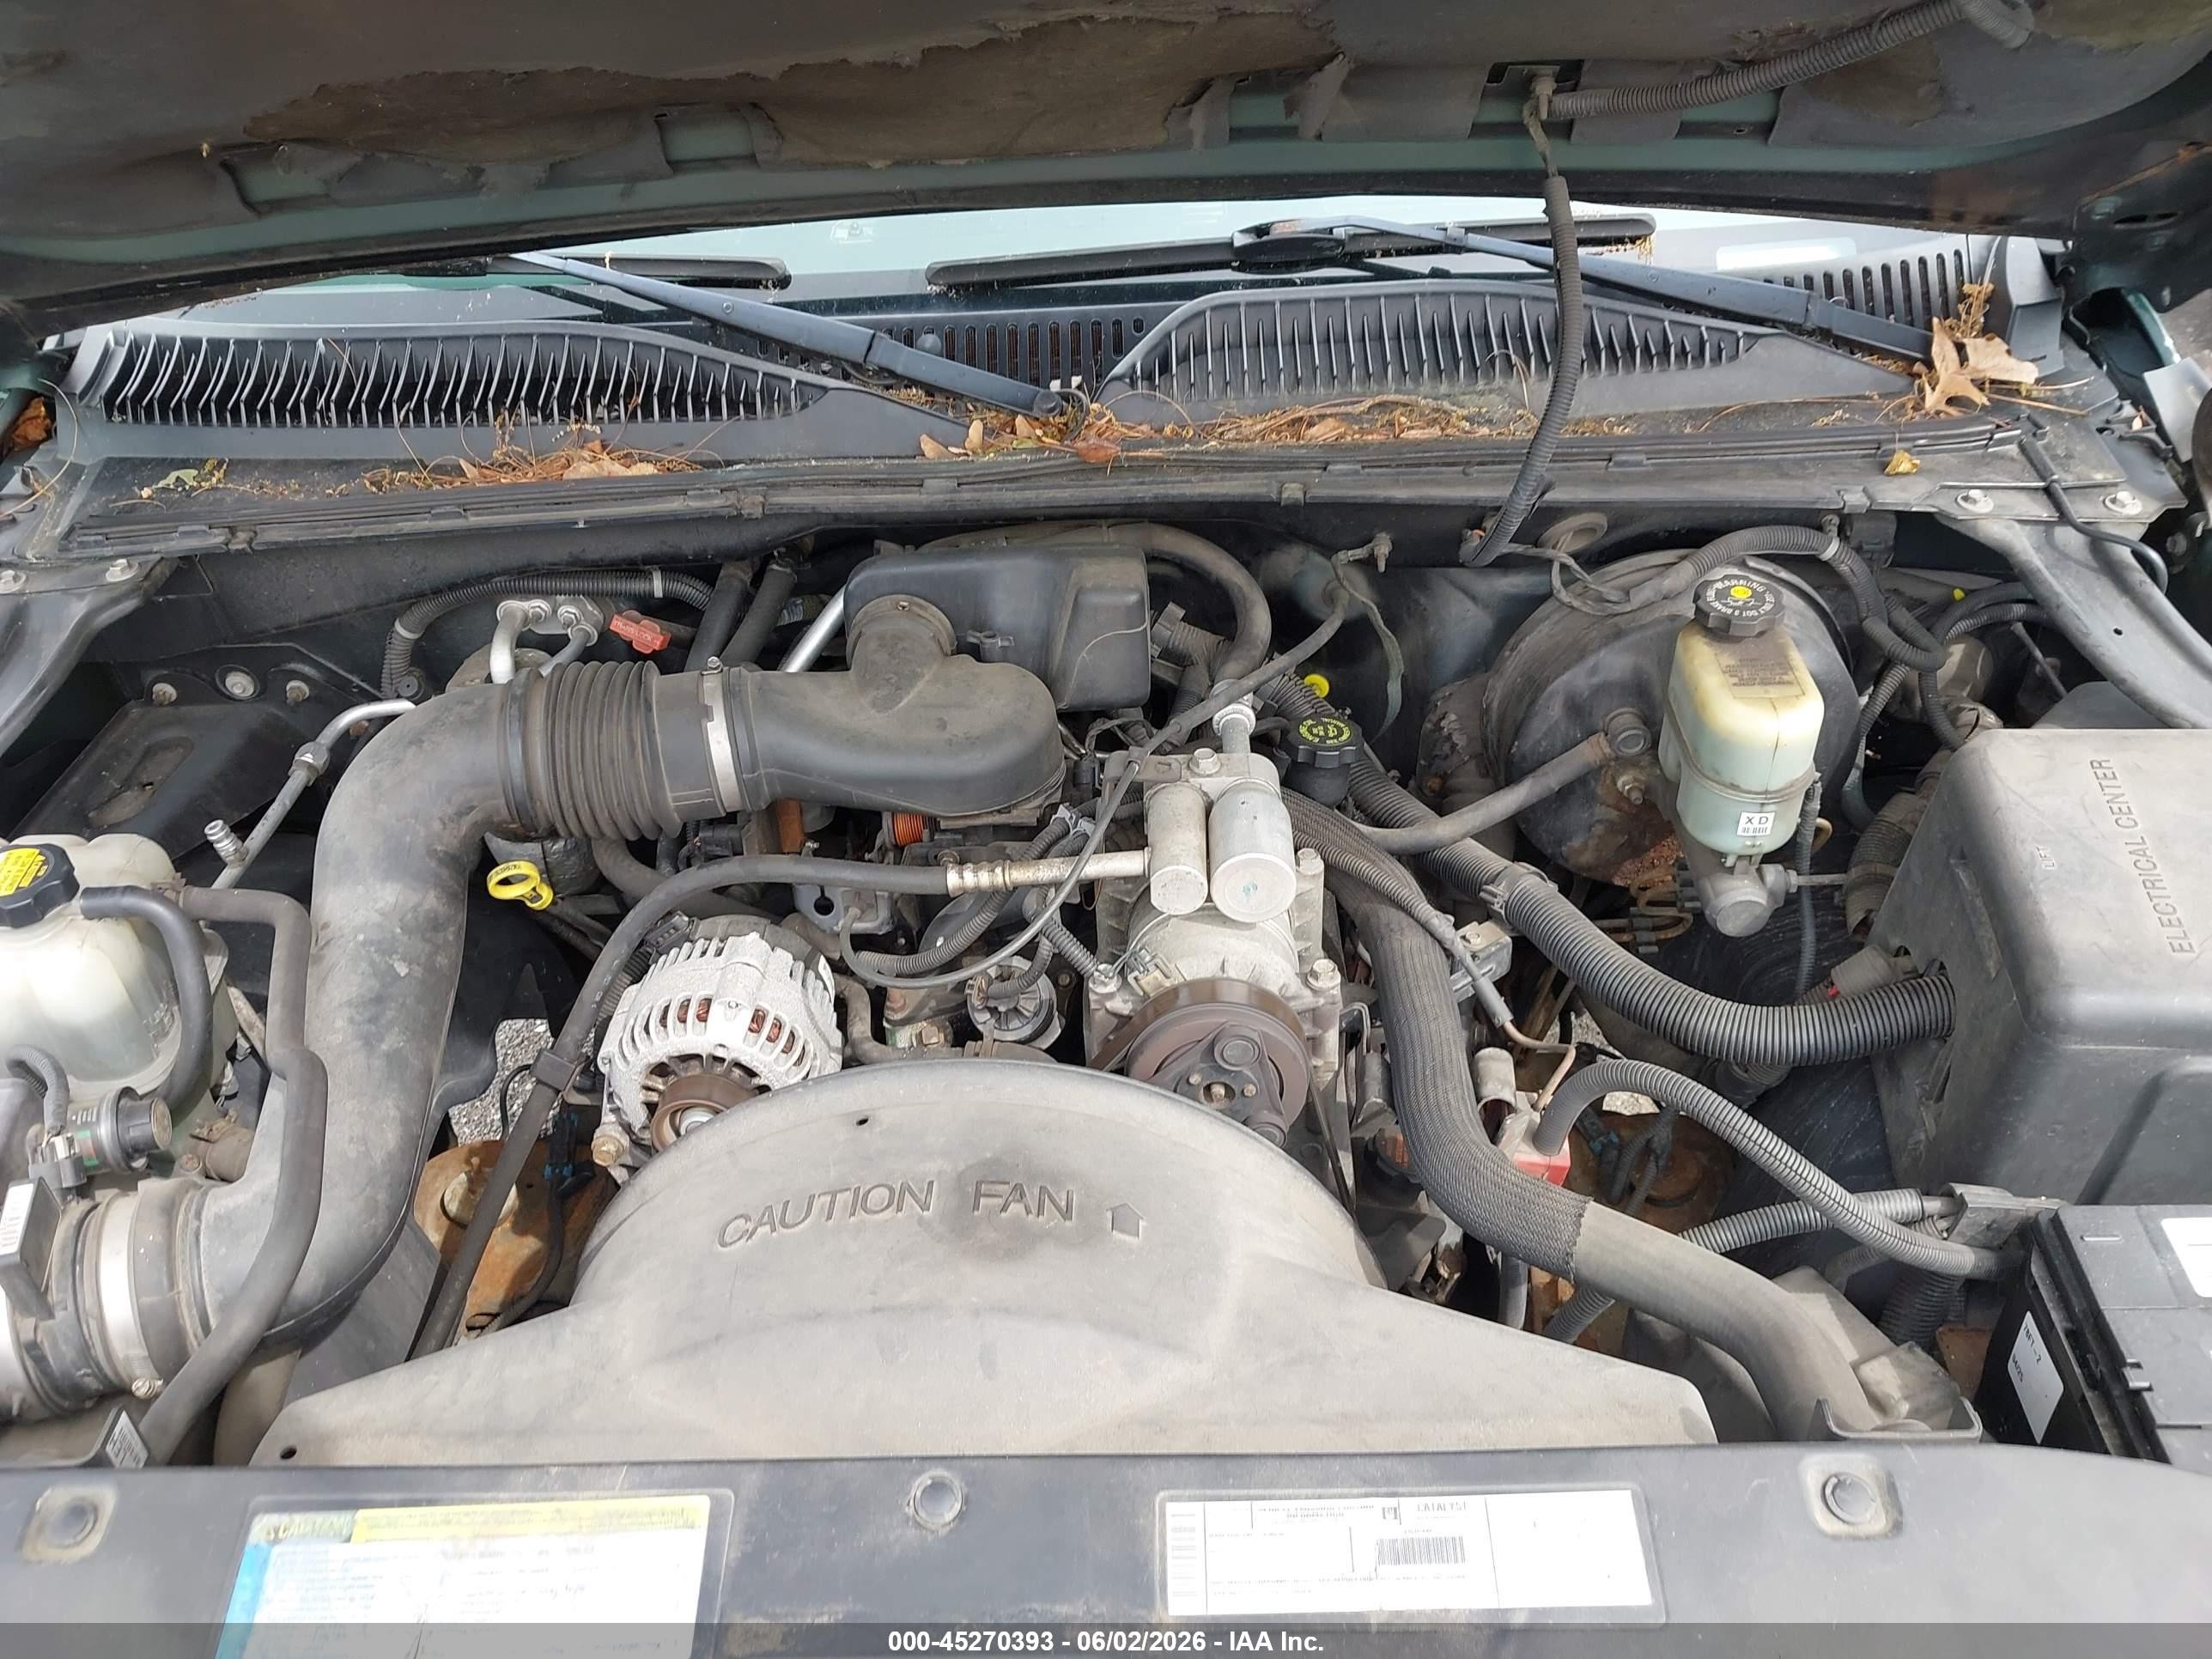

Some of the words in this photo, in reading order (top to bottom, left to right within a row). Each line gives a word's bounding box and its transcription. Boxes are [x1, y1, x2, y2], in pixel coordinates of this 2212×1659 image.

[1712, 579, 1766, 592] WARNING
[2088, 758, 2139, 830] CENTER
[2124, 835, 2197, 954] ELECTRICAL
[716, 1179, 936, 1249] CAUTION
[972, 1179, 1076, 1223] FAN
